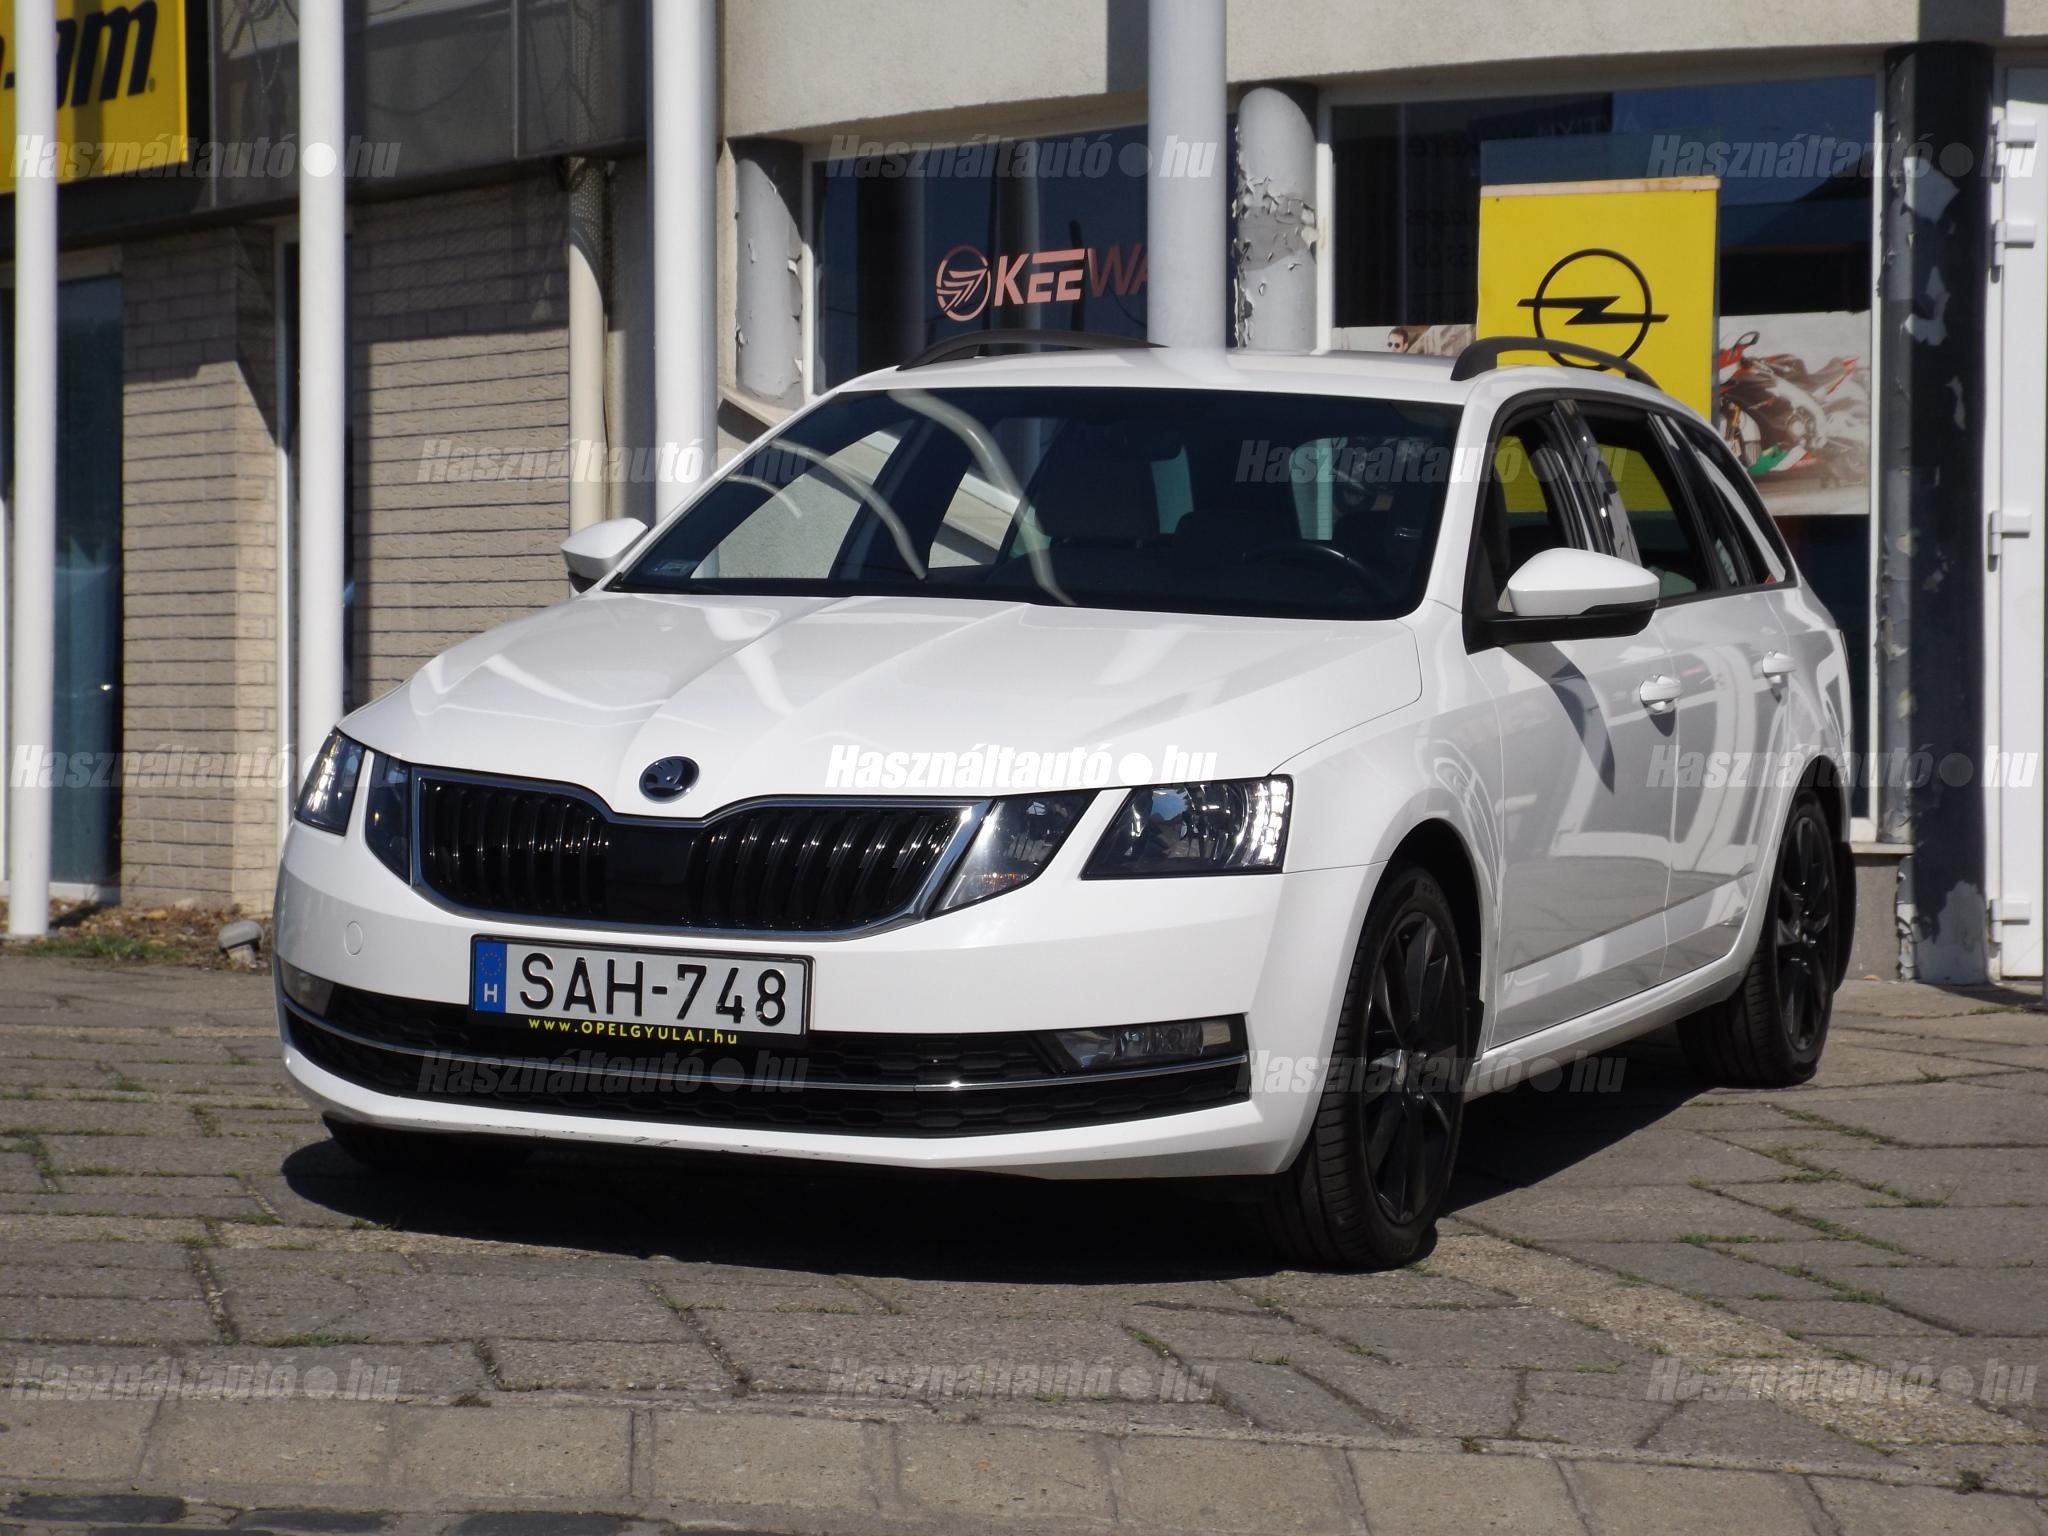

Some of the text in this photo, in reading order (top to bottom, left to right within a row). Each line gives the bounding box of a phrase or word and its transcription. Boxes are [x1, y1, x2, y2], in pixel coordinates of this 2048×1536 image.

[484, 982, 498, 1003] H
[519, 952, 786, 1027] SAH-748
[528, 1017, 738, 1045] www.OPELGYULAI.hu
